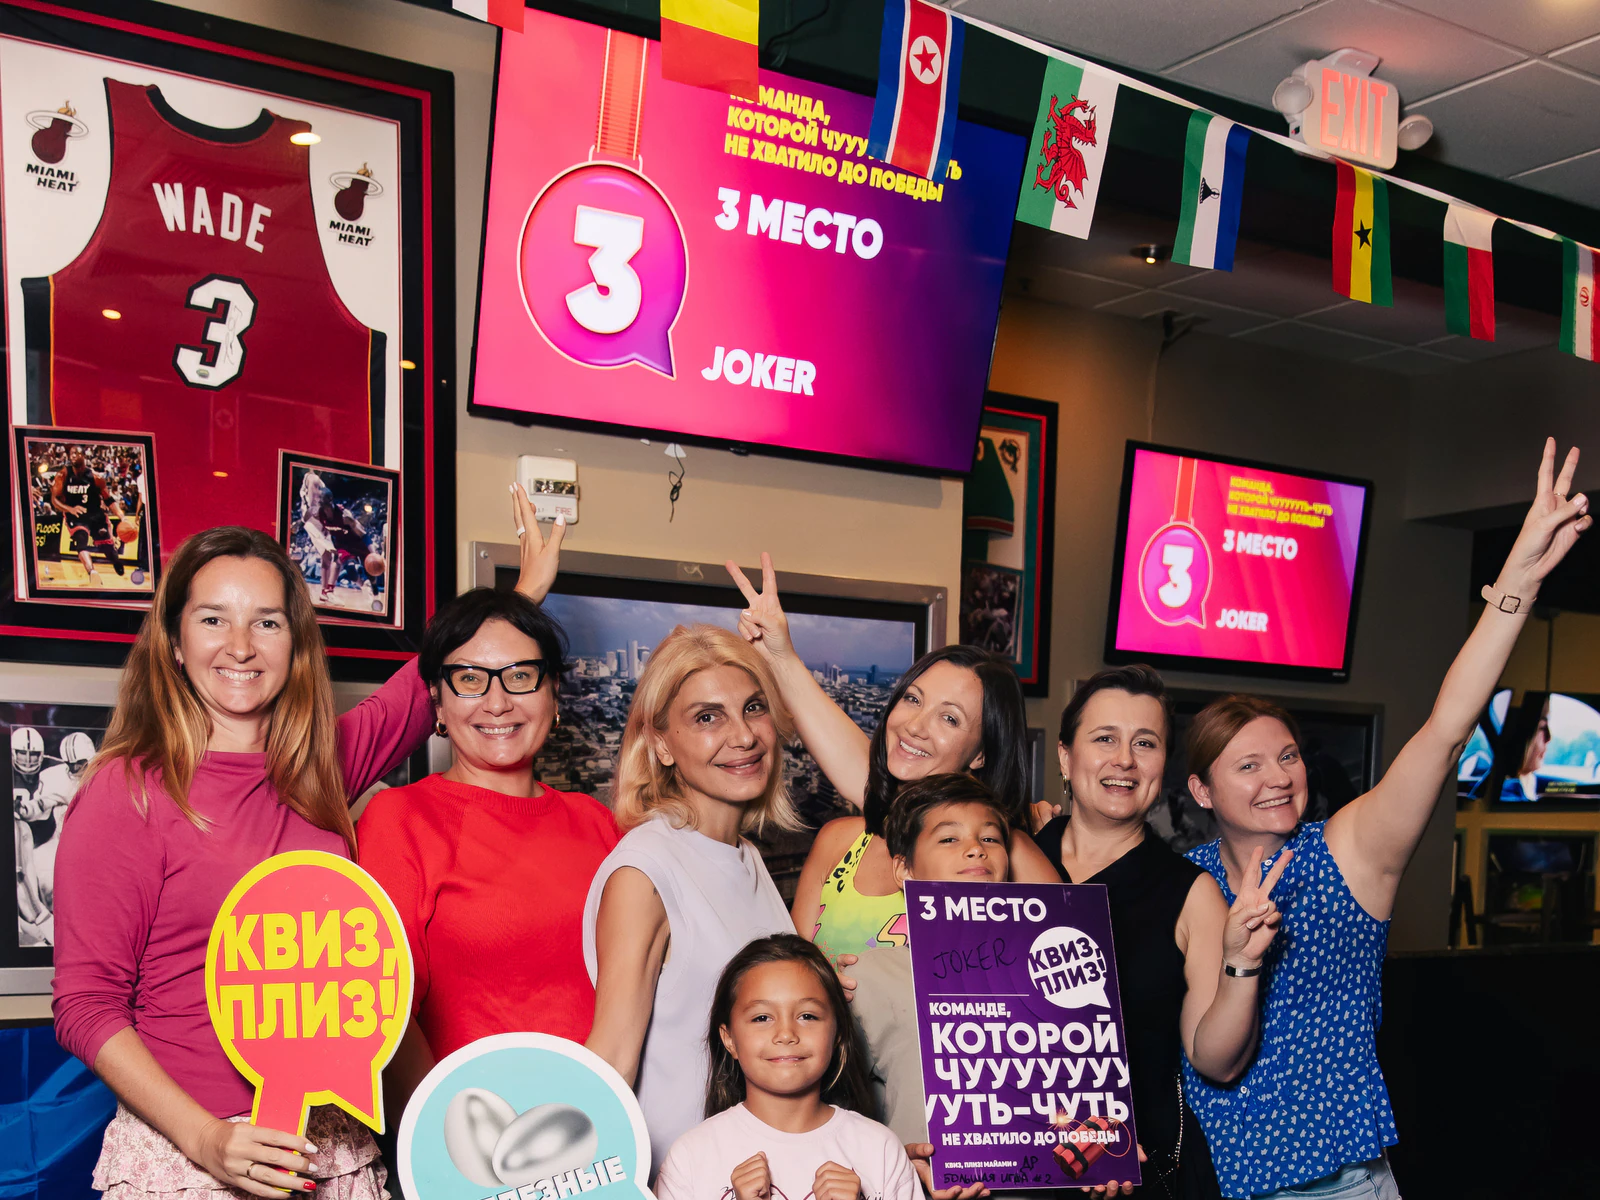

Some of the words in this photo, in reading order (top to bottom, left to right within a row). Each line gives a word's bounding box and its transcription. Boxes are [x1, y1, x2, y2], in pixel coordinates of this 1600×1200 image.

[731, 85, 830, 125] МАНДА,
[1320, 67, 1388, 160] EXIT
[727, 106, 819, 147] КОТОРОЙ
[26, 163, 75, 182] MIAMI
[37, 177, 79, 192] HEAT
[724, 133, 750, 157] НЕ
[751, 139, 838, 178] ХВАТИЛО
[838, 161, 868, 185] ДО
[869, 167, 945, 203] ПОБЕДЫ
[151, 182, 272, 254] WADE
[329, 220, 371, 236] MIAMI
[714, 186, 742, 231] 3
[746, 194, 884, 261] МЕСТО
[338, 233, 375, 247] HEAT
[565, 204, 645, 335] 3
[172, 273, 258, 391] 3
[701, 346, 818, 397] JOKER
[67, 483, 90, 495] HEAT
[81, 494, 88, 504] 3
[555, 506, 572, 516] FIRE
[1222, 529, 1235, 552] 3
[1236, 531, 1299, 560] МЕСТО
[1158, 543, 1194, 608] 3
[1216, 608, 1269, 632] JOKER
[918, 895, 937, 921] 3
[944, 896, 1047, 923] МЕСТО
[223, 907, 397, 976] КВИЗ,
[933, 937, 1017, 979] JOKER
[1029, 937, 1102, 973] КВИЗ,
[1034, 958, 1107, 996] ПЛИЗ!
[219, 978, 396, 1040] ПЛИЗ!
[928, 1002, 1011, 1018] КОМАНДЕ,
[931, 1014, 1120, 1054] КОТОРОЙ
[942, 1133, 961, 1146] НЕ
[963, 1131, 1030, 1146] ХВАТИЛО
[1034, 1131, 1056, 1146] ДО
[1058, 1130, 1120, 1145] ПОБЕДЫ
[943, 1173, 995, 1185] БОЛЬШАЯ
[983, 1159, 1012, 1168] МАЙАМИ
